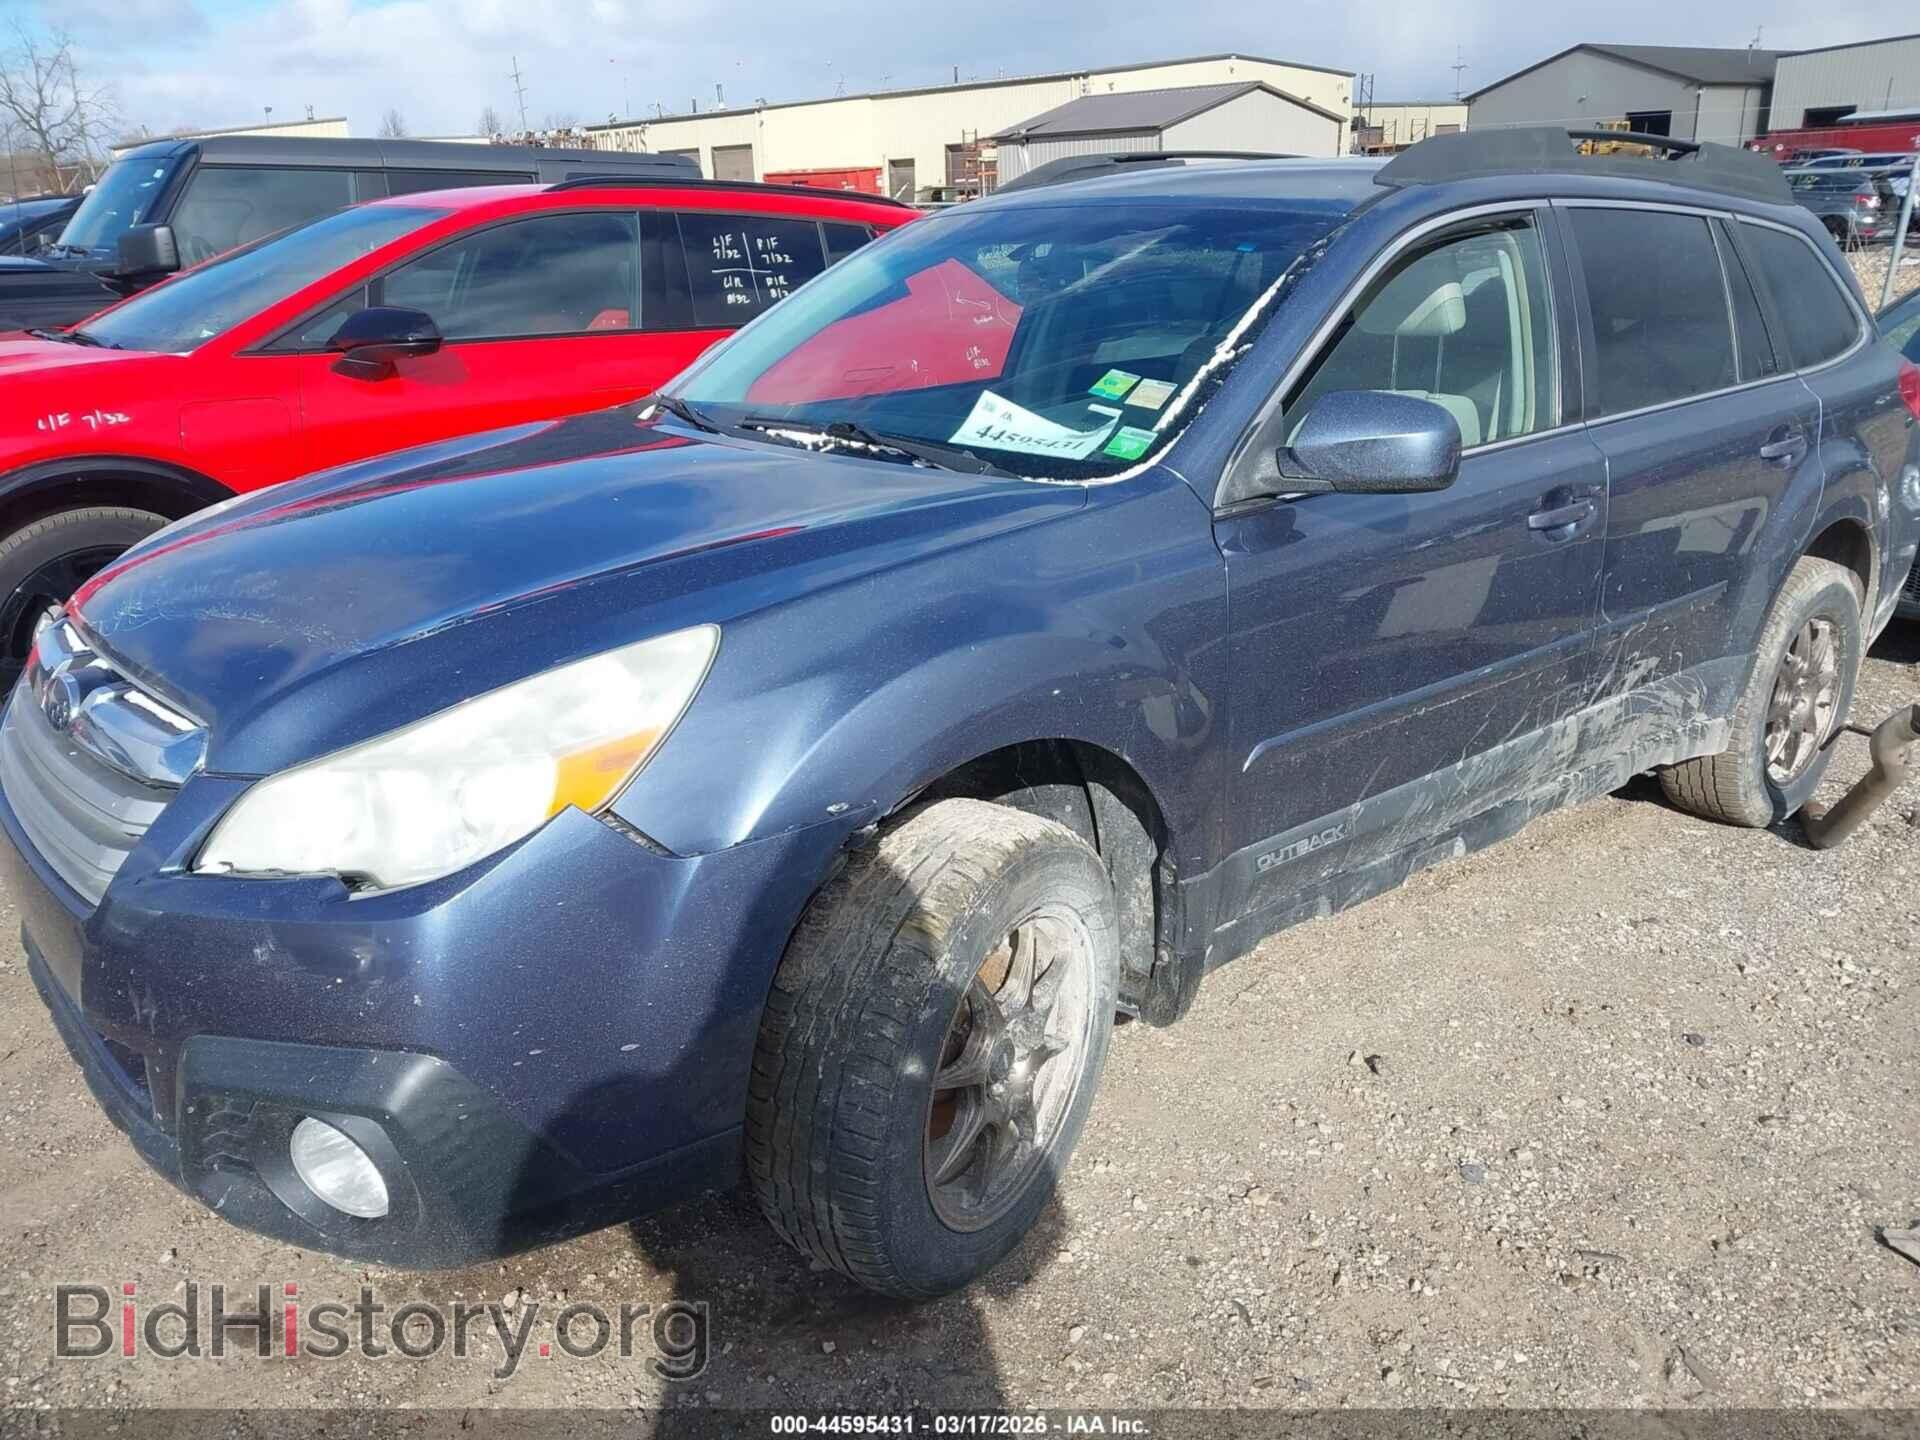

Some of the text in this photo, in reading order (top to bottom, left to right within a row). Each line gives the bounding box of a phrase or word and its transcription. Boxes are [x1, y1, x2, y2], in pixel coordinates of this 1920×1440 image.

[615, 127, 648, 154] PARTS
[81, 409, 130, 430] 7/32
[1257, 824, 1344, 871] OUTBACK
